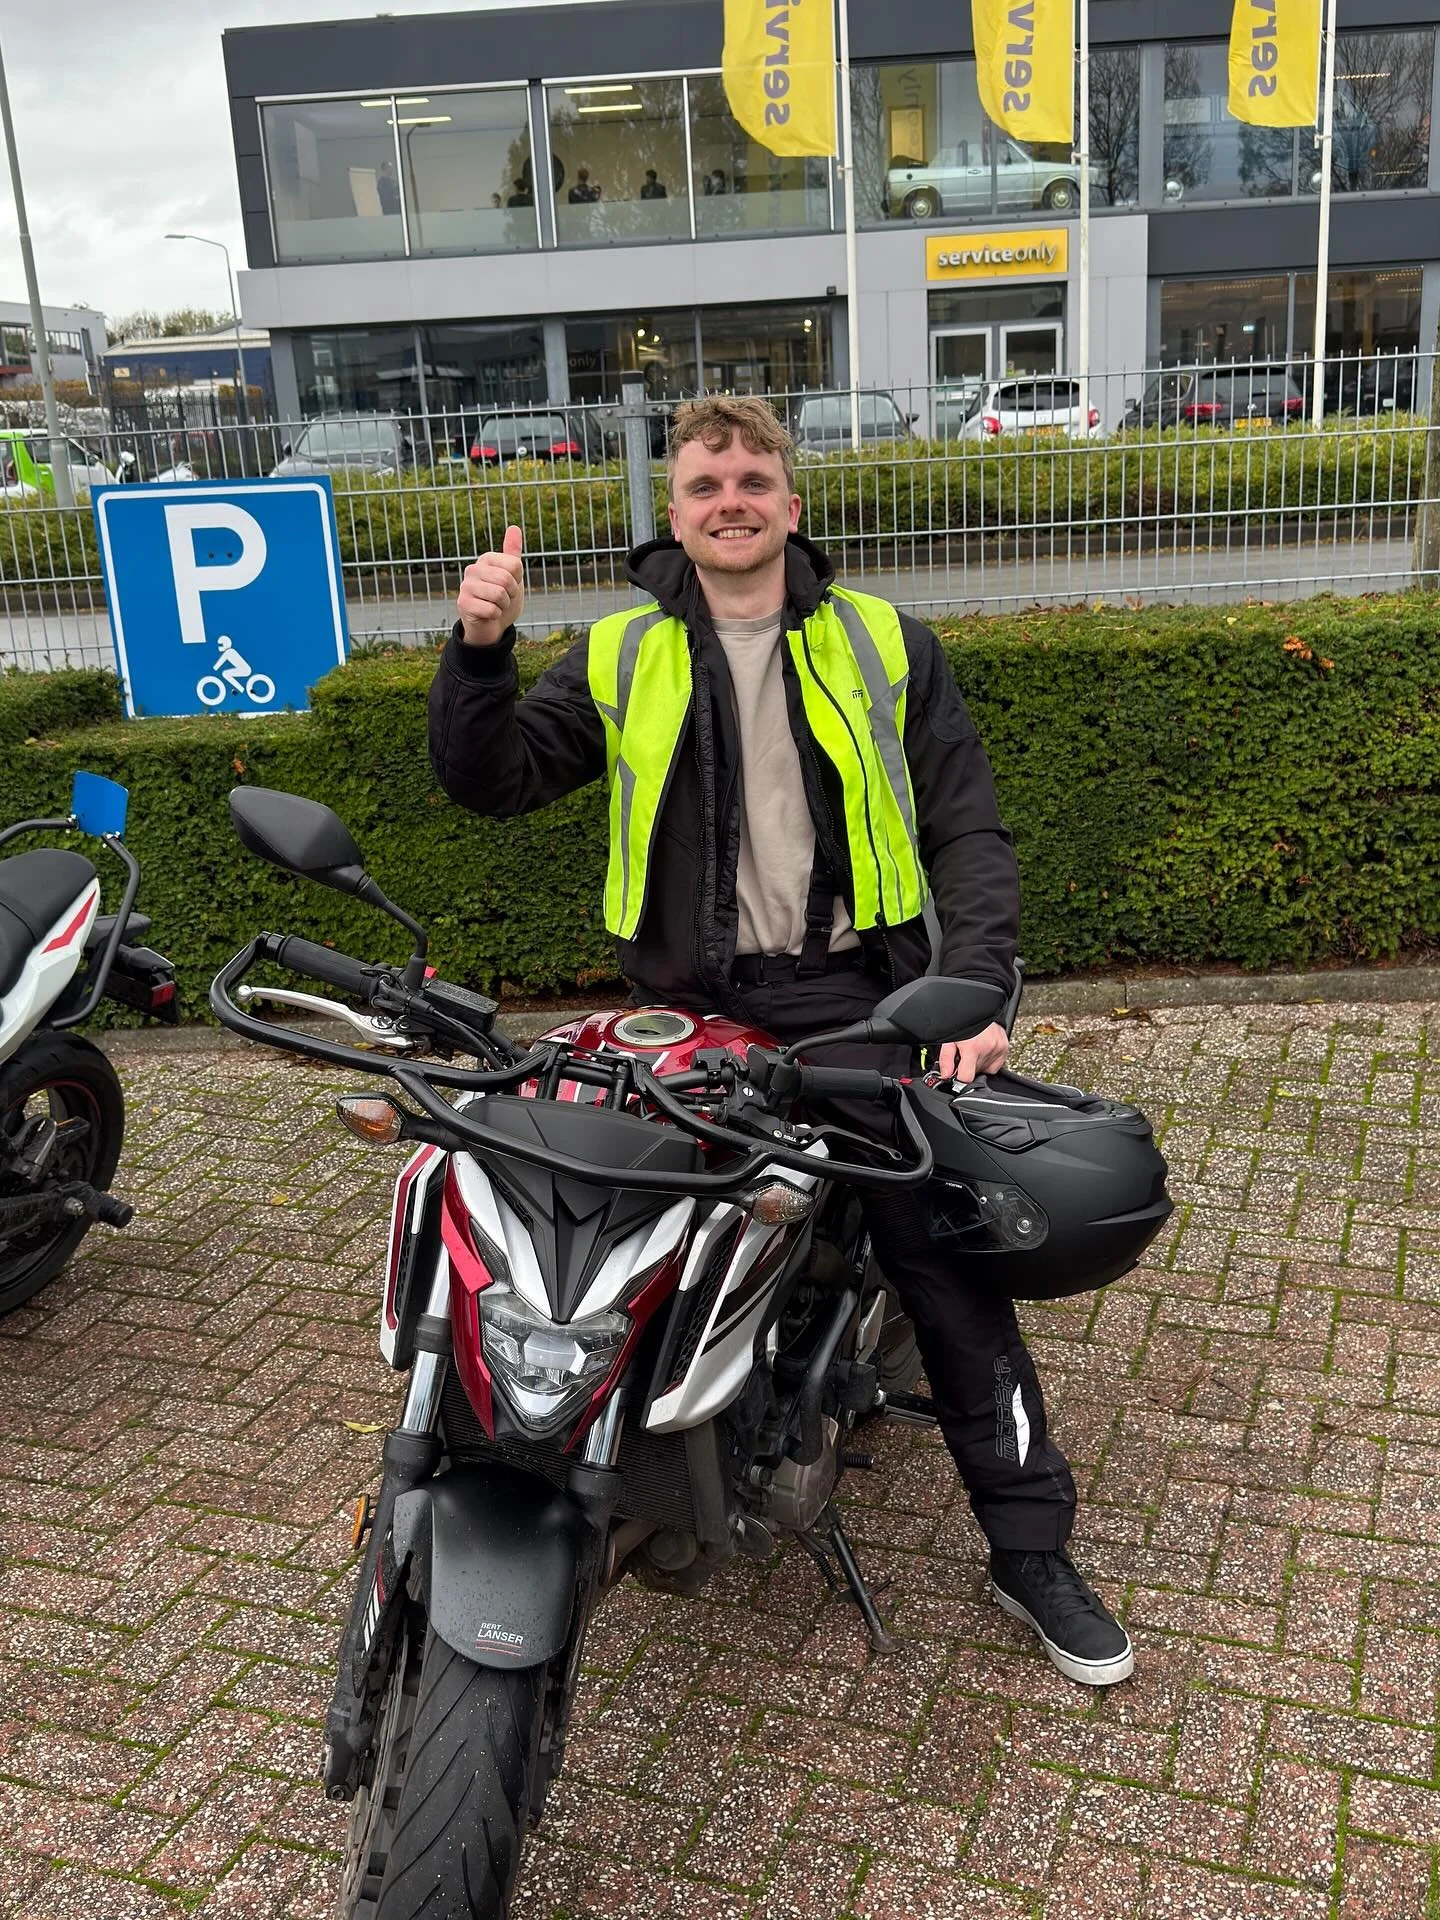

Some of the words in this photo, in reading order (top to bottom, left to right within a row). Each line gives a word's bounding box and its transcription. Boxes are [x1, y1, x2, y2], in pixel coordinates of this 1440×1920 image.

[164, 503, 267, 644] P
[480, 1622, 502, 1630] BERT
[477, 1629, 524, 1645] LANSER
